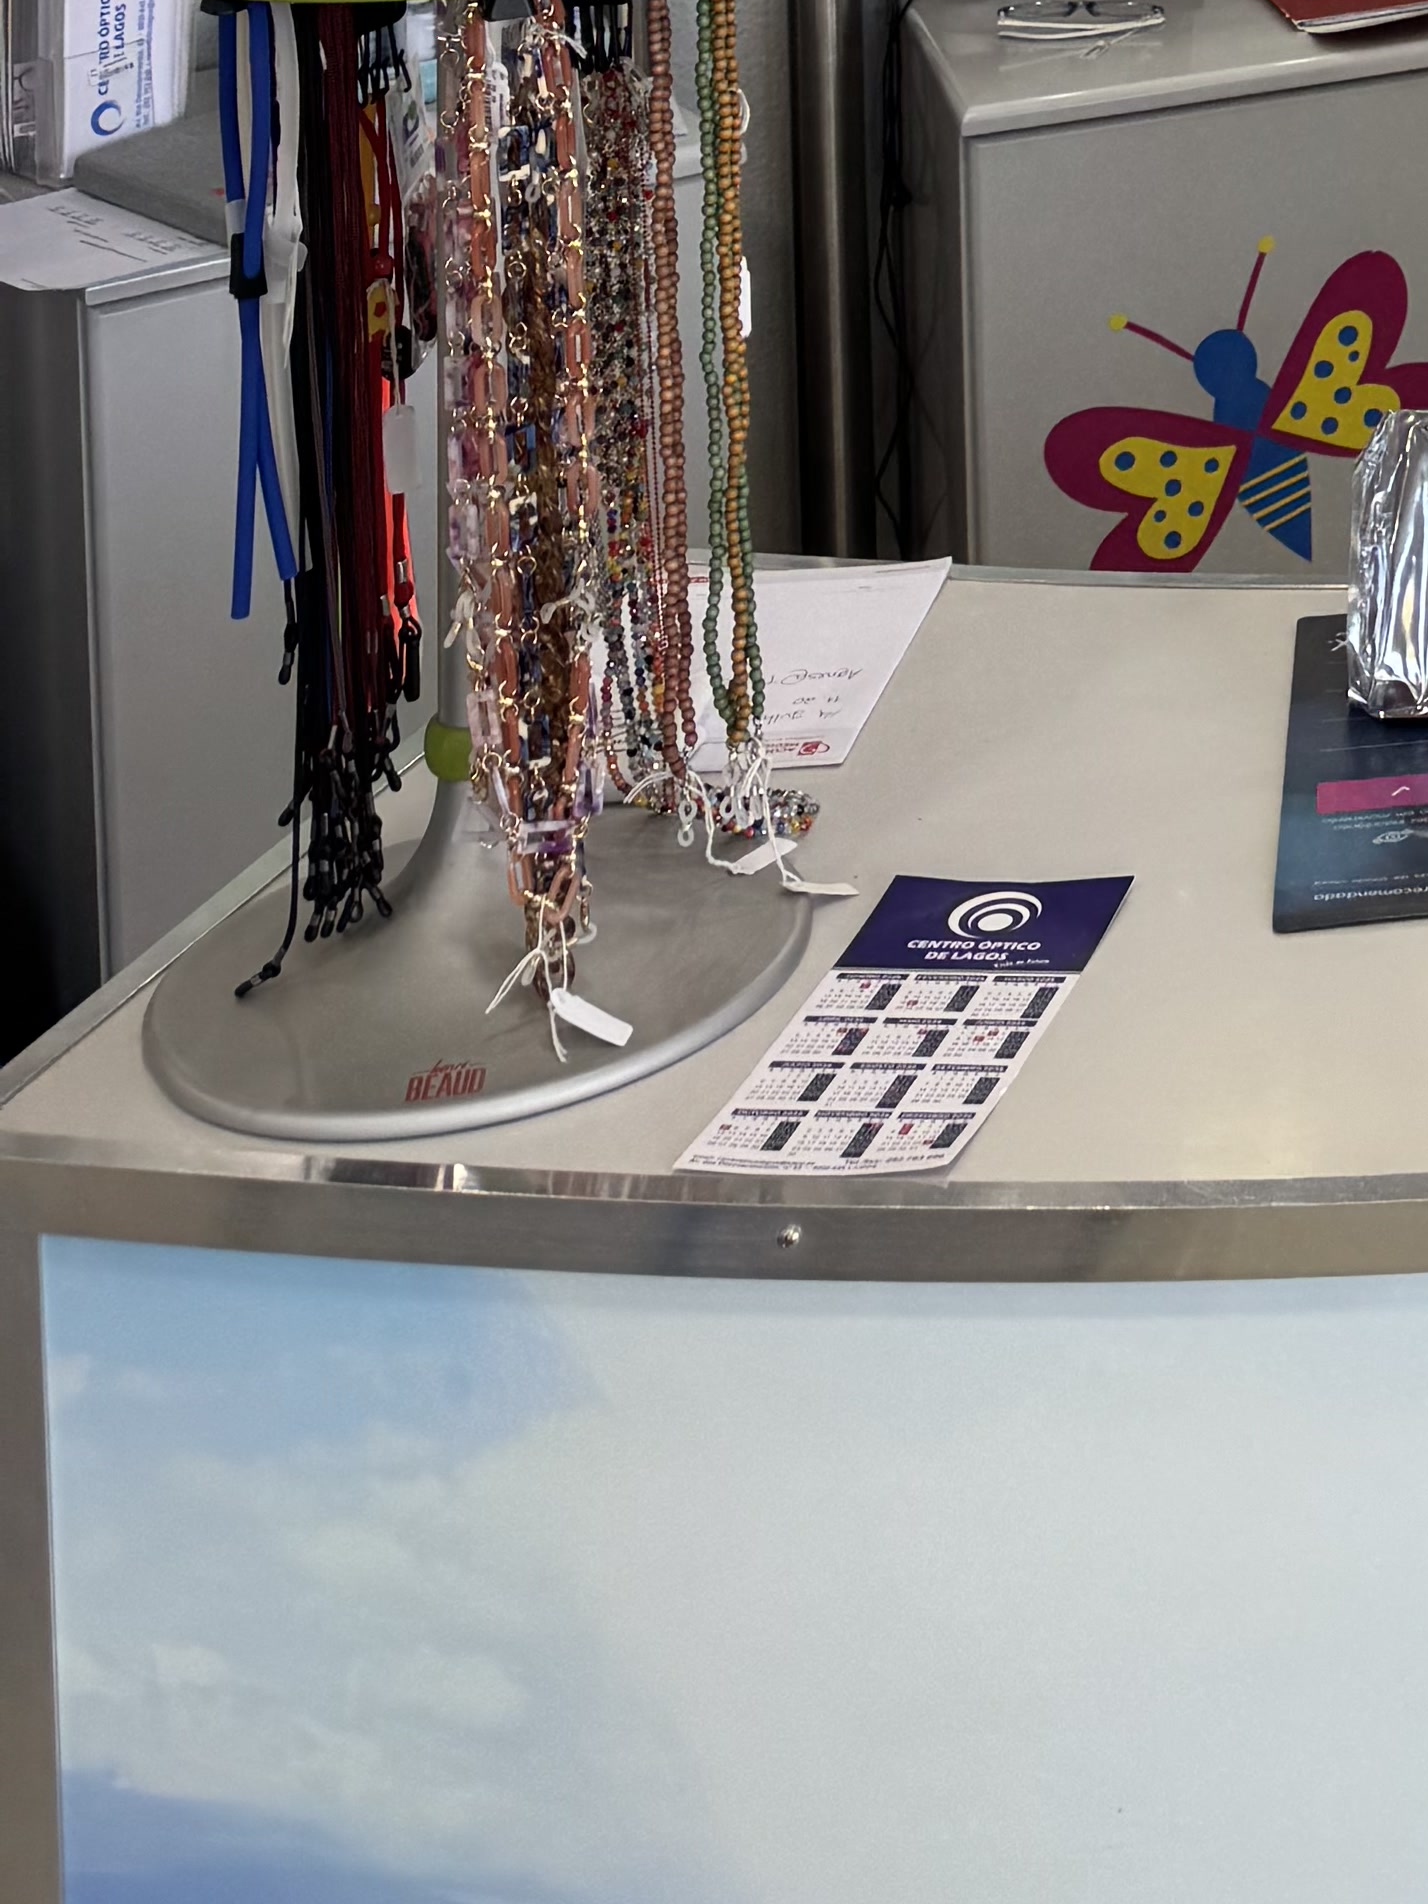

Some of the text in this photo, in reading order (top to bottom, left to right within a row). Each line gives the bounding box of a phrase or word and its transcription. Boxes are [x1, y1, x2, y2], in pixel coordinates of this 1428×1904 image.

[113, 3, 127, 49] LAGOS
[1313, 885, 1428, 902] recomendada
[907, 938, 1041, 951] CENTRO ÓPTICO
[924, 951, 1009, 961] DE LAGOS
[405, 1068, 486, 1102] BEAUD
